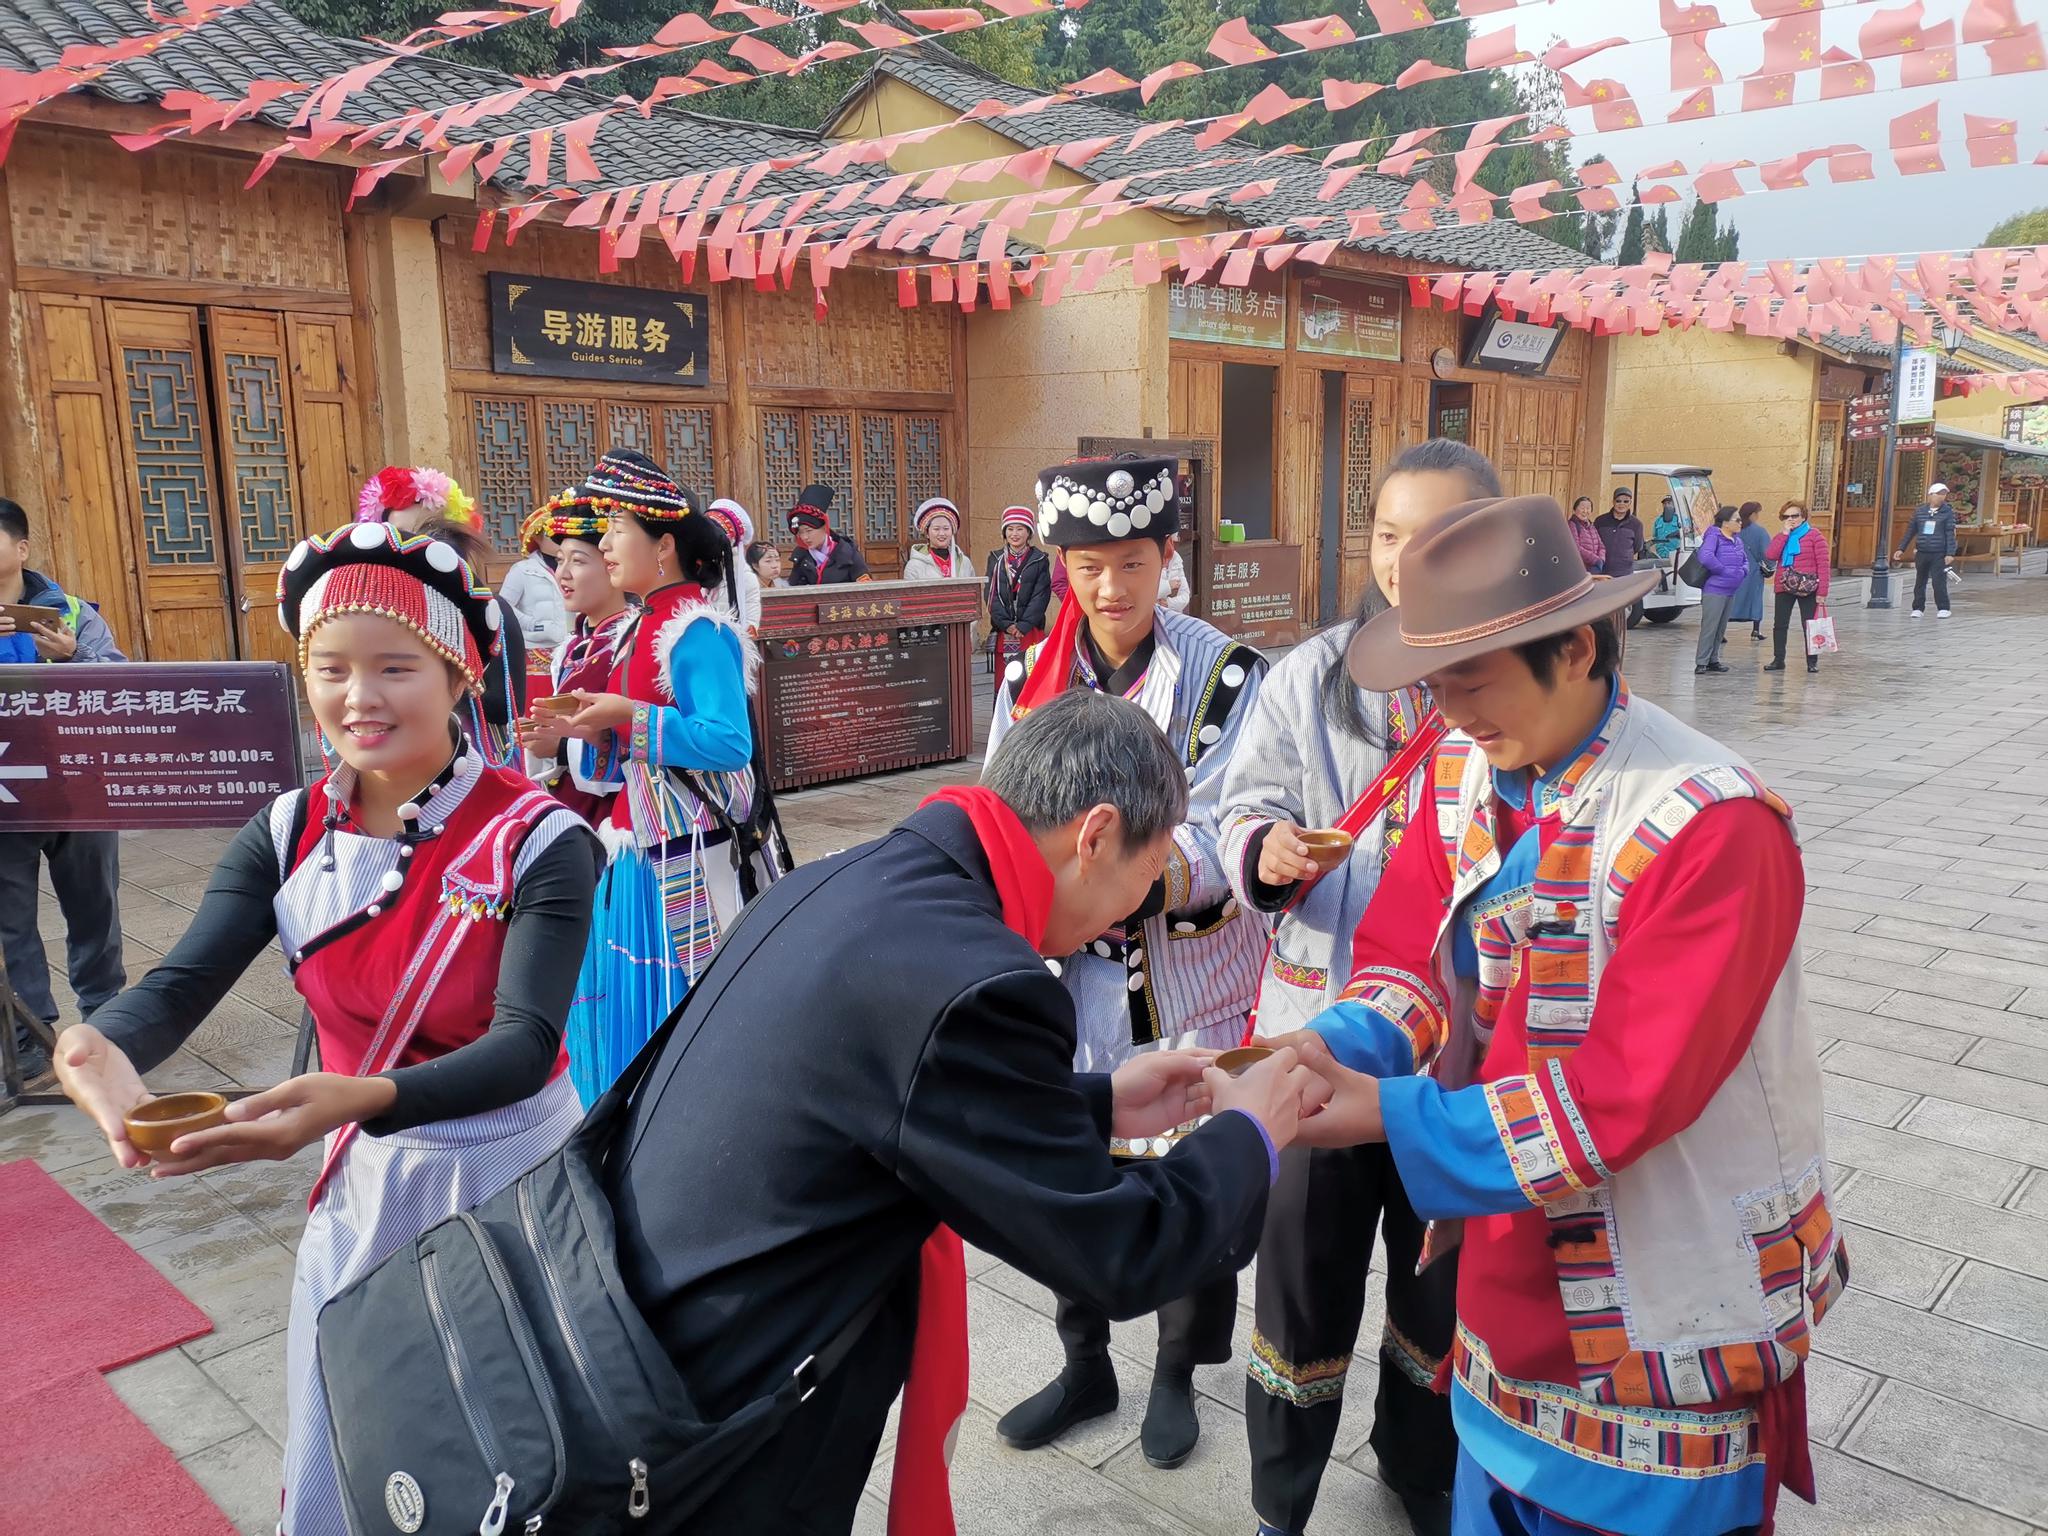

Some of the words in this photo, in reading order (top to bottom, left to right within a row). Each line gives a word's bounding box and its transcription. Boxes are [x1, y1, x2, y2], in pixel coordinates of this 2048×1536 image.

[1170, 278, 1277, 319] 电瓶车服务点
[541, 309, 671, 353] 导游服务
[571, 351, 605, 364] Guides
[608, 354, 643, 366] Service
[96, 724, 123, 735] sight
[124, 724, 158, 735] seeing
[160, 725, 177, 734] car
[100, 752, 109, 765] 7
[209, 749, 275, 763] 300.00元
[217, 781, 282, 795] 500.00元
